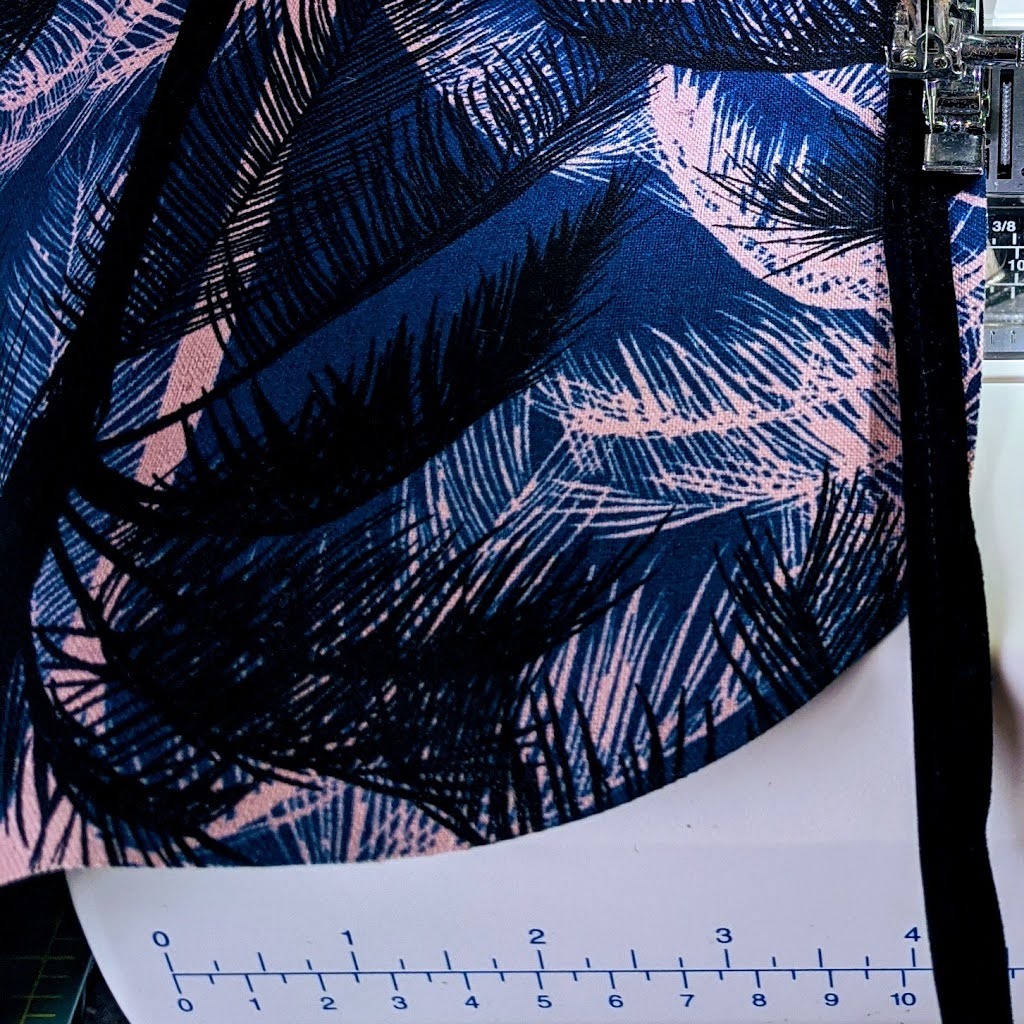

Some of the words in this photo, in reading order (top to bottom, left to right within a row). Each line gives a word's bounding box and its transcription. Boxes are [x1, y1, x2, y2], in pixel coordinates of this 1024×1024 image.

[991, 220, 1017, 232] 3/8
[340, 929, 354, 946] 1
[528, 928, 547, 945] 2
[715, 927, 734, 944] 3
[903, 926, 921, 943] 4
[248, 997, 261, 1012] 1
[319, 996, 338, 1011] 2
[390, 995, 409, 1010] 3
[464, 995, 481, 1009] 4
[536, 994, 553, 1009] 5
[608, 994, 624, 1009] 6
[679, 993, 695, 1008] 7
[751, 993, 768, 1008] 8
[823, 992, 840, 1007] 9
[889, 992, 917, 1007] 10
